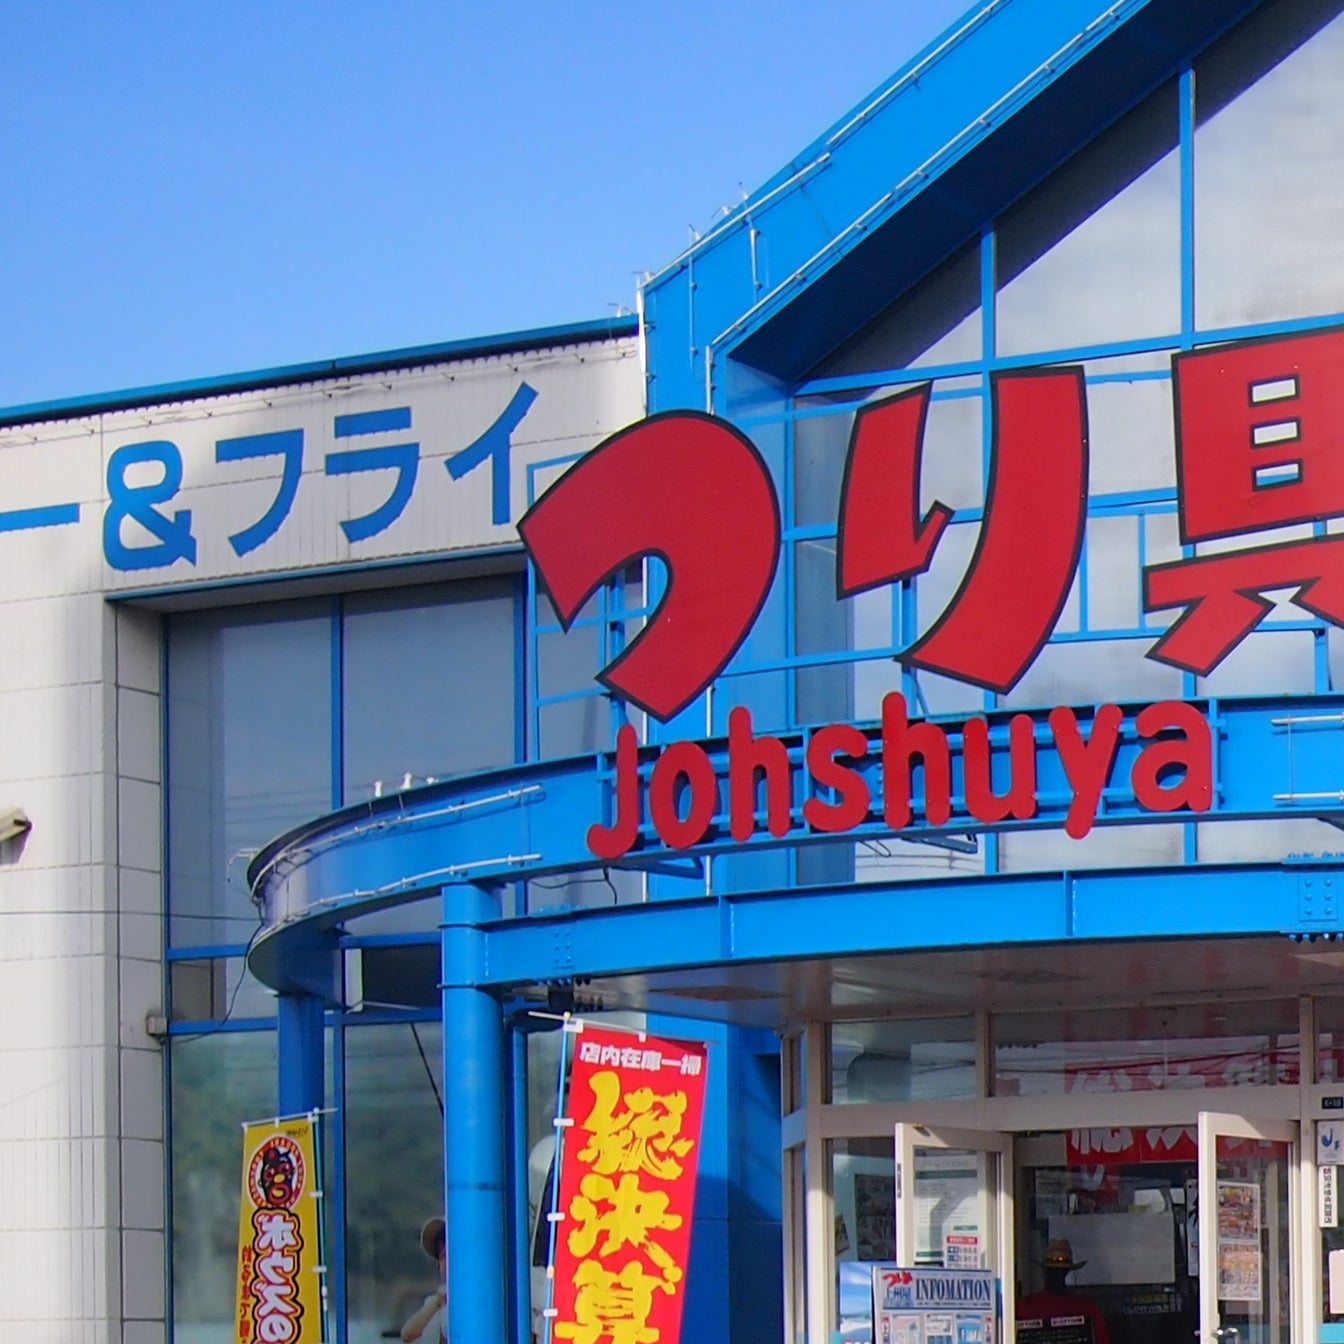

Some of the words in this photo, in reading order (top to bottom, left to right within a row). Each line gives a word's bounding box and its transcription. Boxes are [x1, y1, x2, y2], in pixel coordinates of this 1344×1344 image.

[585, 691, 1212, 860] Johshuya
[580, 1041, 702, 1077] 店内在庫一掃
[915, 1278, 991, 1300] INFOMATION
